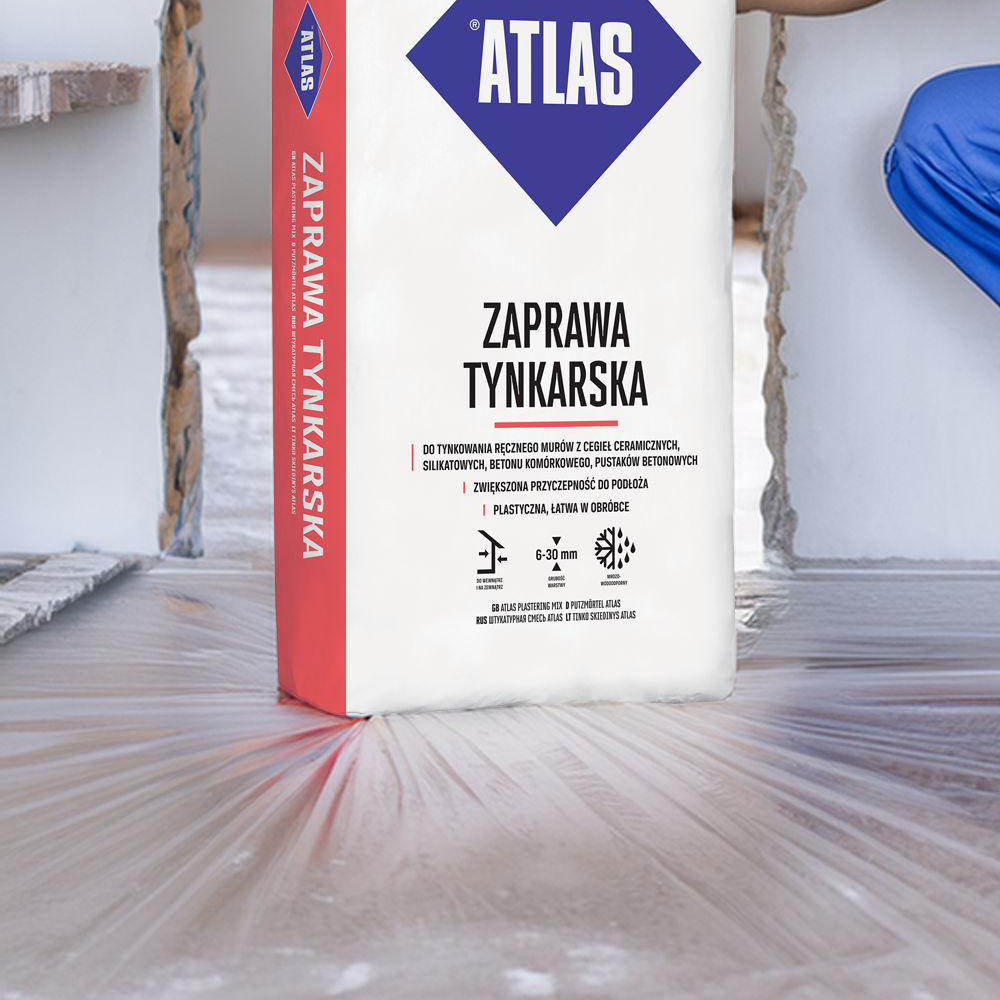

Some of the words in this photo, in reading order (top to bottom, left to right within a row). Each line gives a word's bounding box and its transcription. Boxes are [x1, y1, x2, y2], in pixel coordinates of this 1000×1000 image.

[301, 30, 314, 91] ATLAS
[478, 19, 633, 106] ATLAS
[303, 151, 324, 328] ZAPRAWA
[482, 302, 631, 349] ZAPRAWA
[463, 361, 649, 408] TYNKARSKA
[302, 339, 324, 559] TYNKARSKA
[423, 444, 435, 455] DO
[437, 443, 492, 455] TYNKOWANIA
[494, 442, 538, 456] RĘCZNEGO
[541, 440, 574, 453] MURÓW
[576, 441, 581, 452] Z
[584, 441, 611, 452] CEGIEŁ
[614, 440, 680, 452] CERAMICZNYCH,
[423, 460, 487, 472] SILIKATOWYCH,
[490, 458, 523, 469] BETONU
[525, 456, 593, 469] KOMÓRKOWEGO,
[595, 454, 639, 468] PUSTAKÓW
[642, 455, 698, 467] BETONOWYCH
[474, 482, 528, 494] ZWIĘKSZONA
[531, 477, 596, 492] PRZYCZEPNOŚĆ
[598, 479, 609, 490] DO
[612, 476, 648, 490] PODŁOŻA
[493, 504, 548, 516] PLASTYCZNA,
[551, 503, 578, 514] ŁATWA
[580, 502, 588, 513] W
[591, 500, 629, 512] OBRÓBCE
[536, 549, 558, 561] 6-30
[561, 550, 577, 560] mm
[492, 604, 499, 612] GB
[501, 603, 516, 612] ATLAS
[517, 602, 550, 611] PLASTERING
[551, 601, 562, 610] MIX
[565, 601, 569, 610] D
[571, 599, 604, 609] PUTZMÖRTEL
[605, 599, 621, 608] ATLAS
[476, 616, 487, 625] RUS
[547, 613, 563, 622] ATLAS
[565, 613, 571, 621] LT
[573, 612, 589, 621] TINKO
[590, 611, 619, 620] SKIEDINYS
[621, 611, 636, 619] ATLAS
